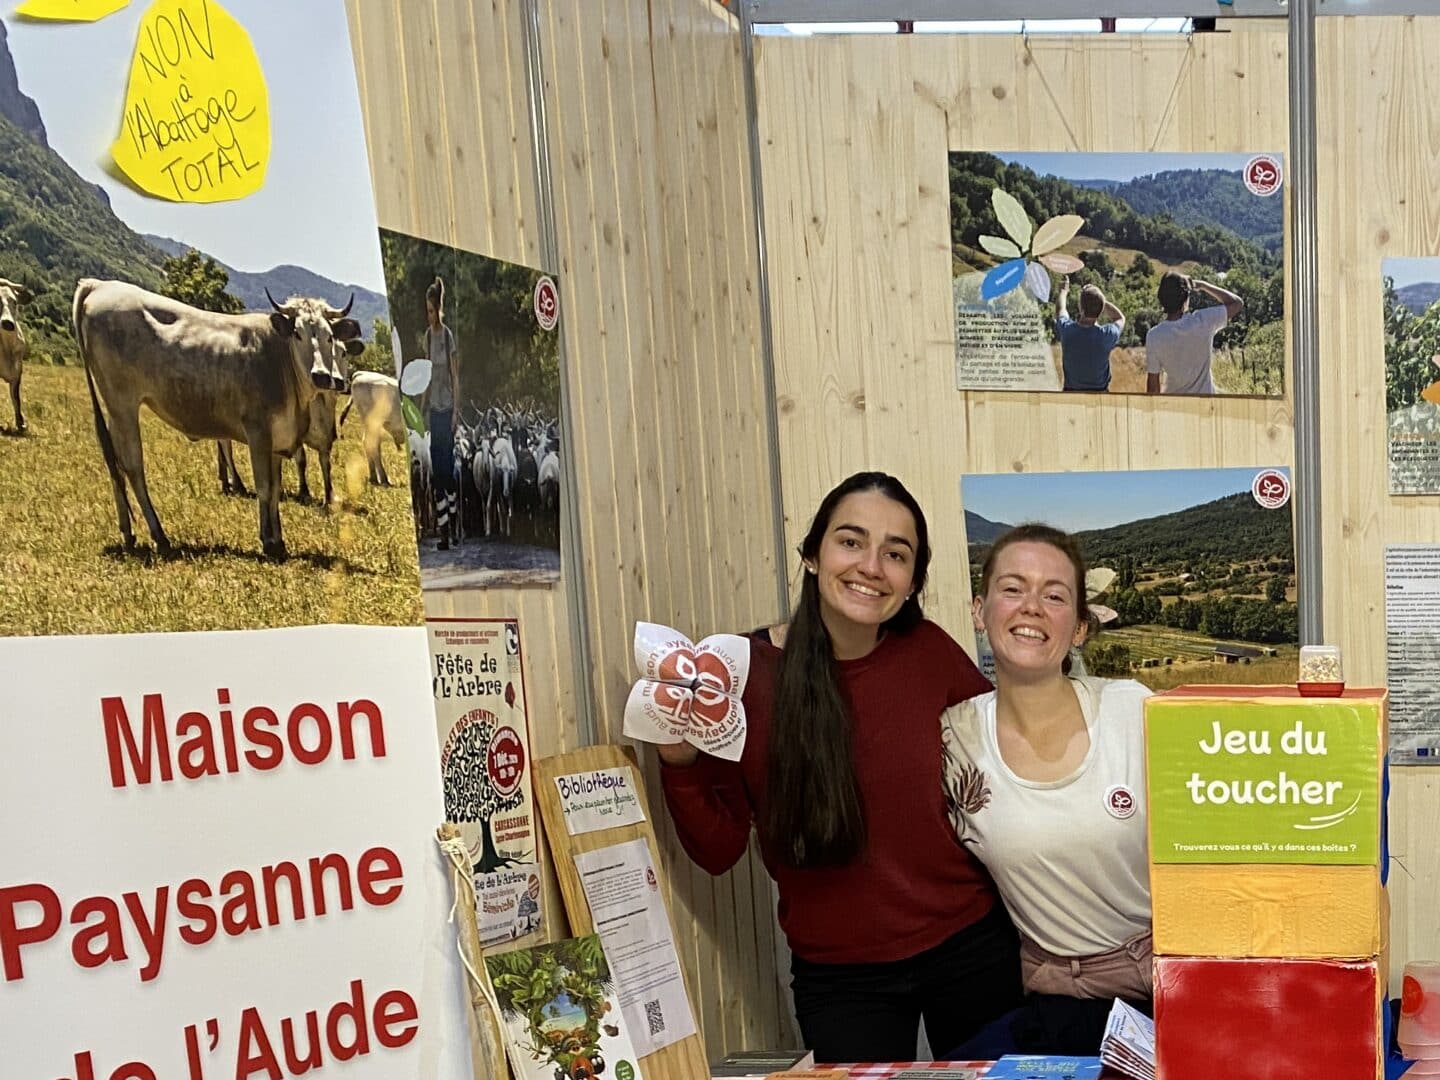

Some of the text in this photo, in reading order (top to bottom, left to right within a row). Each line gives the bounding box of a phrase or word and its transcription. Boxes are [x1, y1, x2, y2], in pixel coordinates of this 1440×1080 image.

[140, 0, 214, 83] NON
[178, 74, 193, 103] à
[161, 139, 260, 200] TOTAL
[434, 652, 498, 676] Fête de
[101, 687, 388, 789] Maison
[1198, 720, 1328, 756] Jeu du
[558, 771, 627, 806] Bibliothèque
[1185, 771, 1344, 806] toucher
[1173, 842, 1218, 852] Trouverez
[1218, 843, 1240, 851] vous
[1240, 843, 1251, 851] ce
[1284, 842, 1305, 851] dans
[1305, 844, 1322, 852] ces
[0, 844, 405, 983] Paysanne
